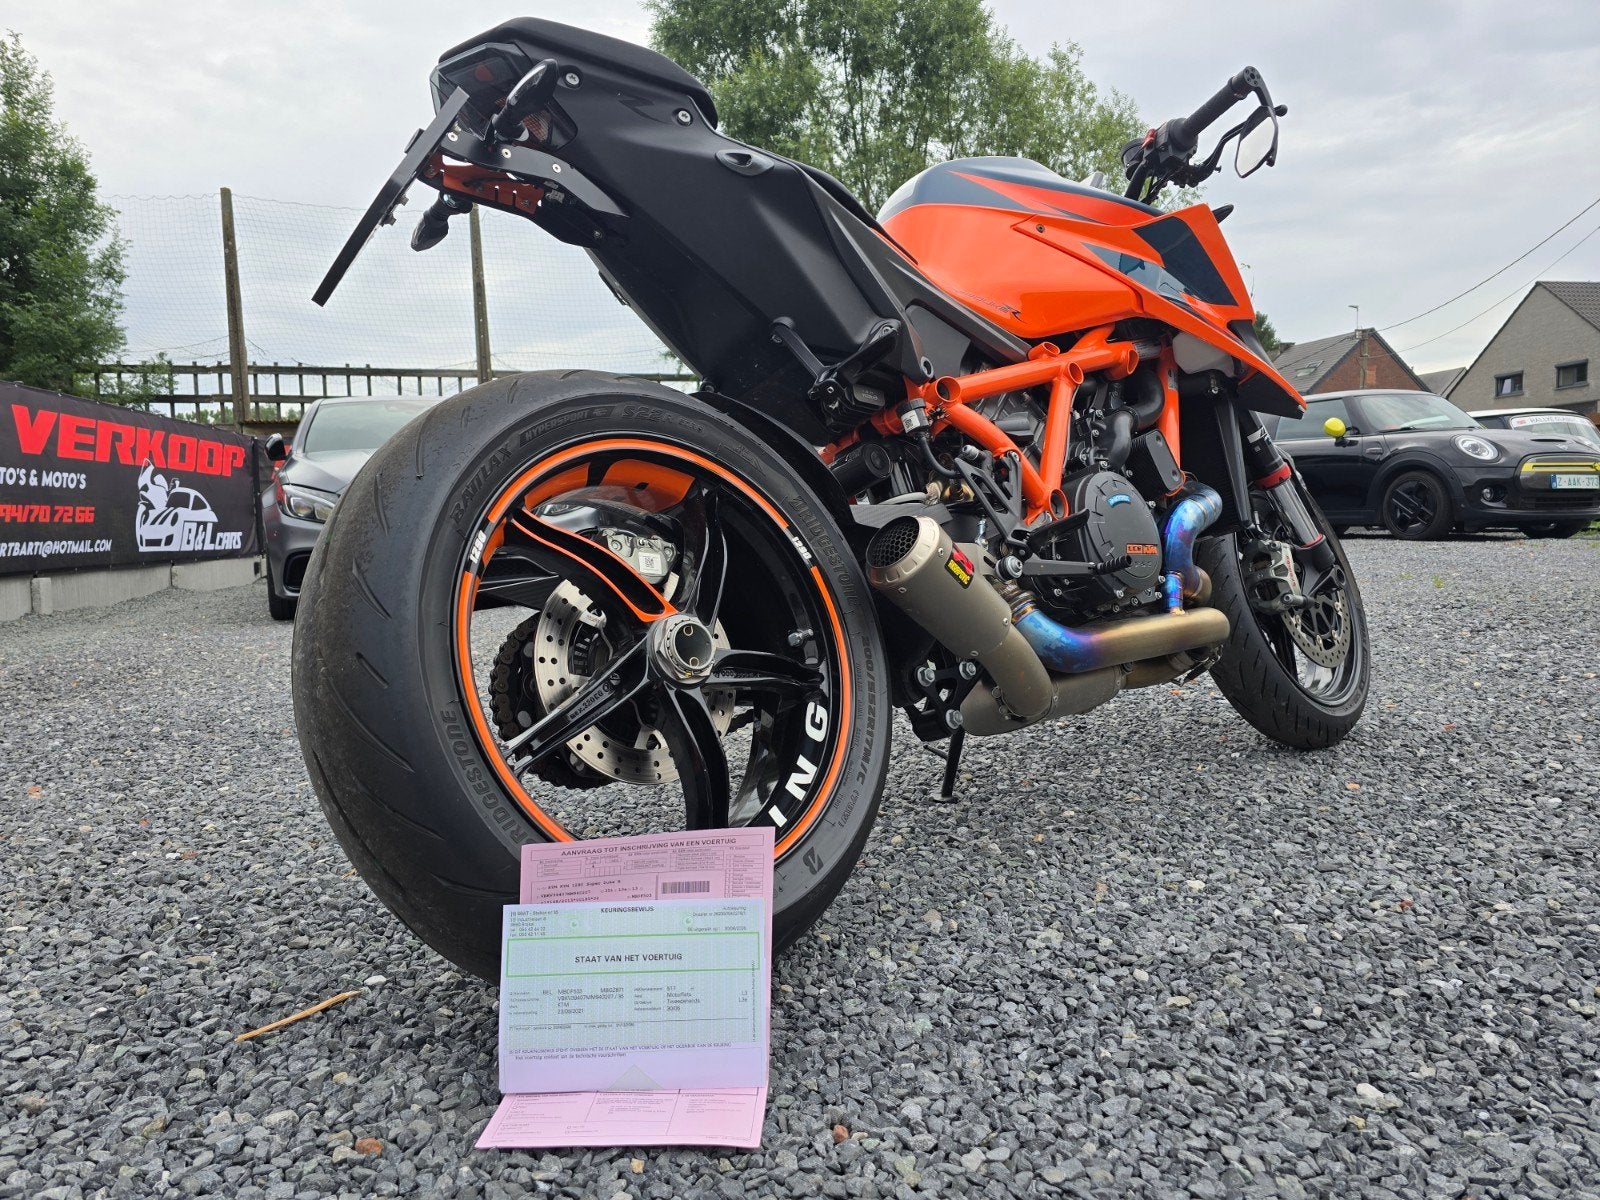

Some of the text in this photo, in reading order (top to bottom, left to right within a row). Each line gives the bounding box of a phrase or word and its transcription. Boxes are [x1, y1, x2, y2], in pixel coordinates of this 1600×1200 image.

[525, 410, 589, 440] HYPERSPORT
[12, 404, 245, 477] VERKOOP
[29, 469, 38, 486] &
[41, 470, 87, 489] MOTO'S
[54, 505, 73, 523] 72
[75, 506, 95, 523] 66
[440, 708, 534, 844] RIDGESTONE
[620, 842, 668, 851] INSCHRIJVING
[575, 955, 602, 963] STAAT
[624, 954, 640, 962] HET
[642, 953, 683, 961] VOERTUIG
